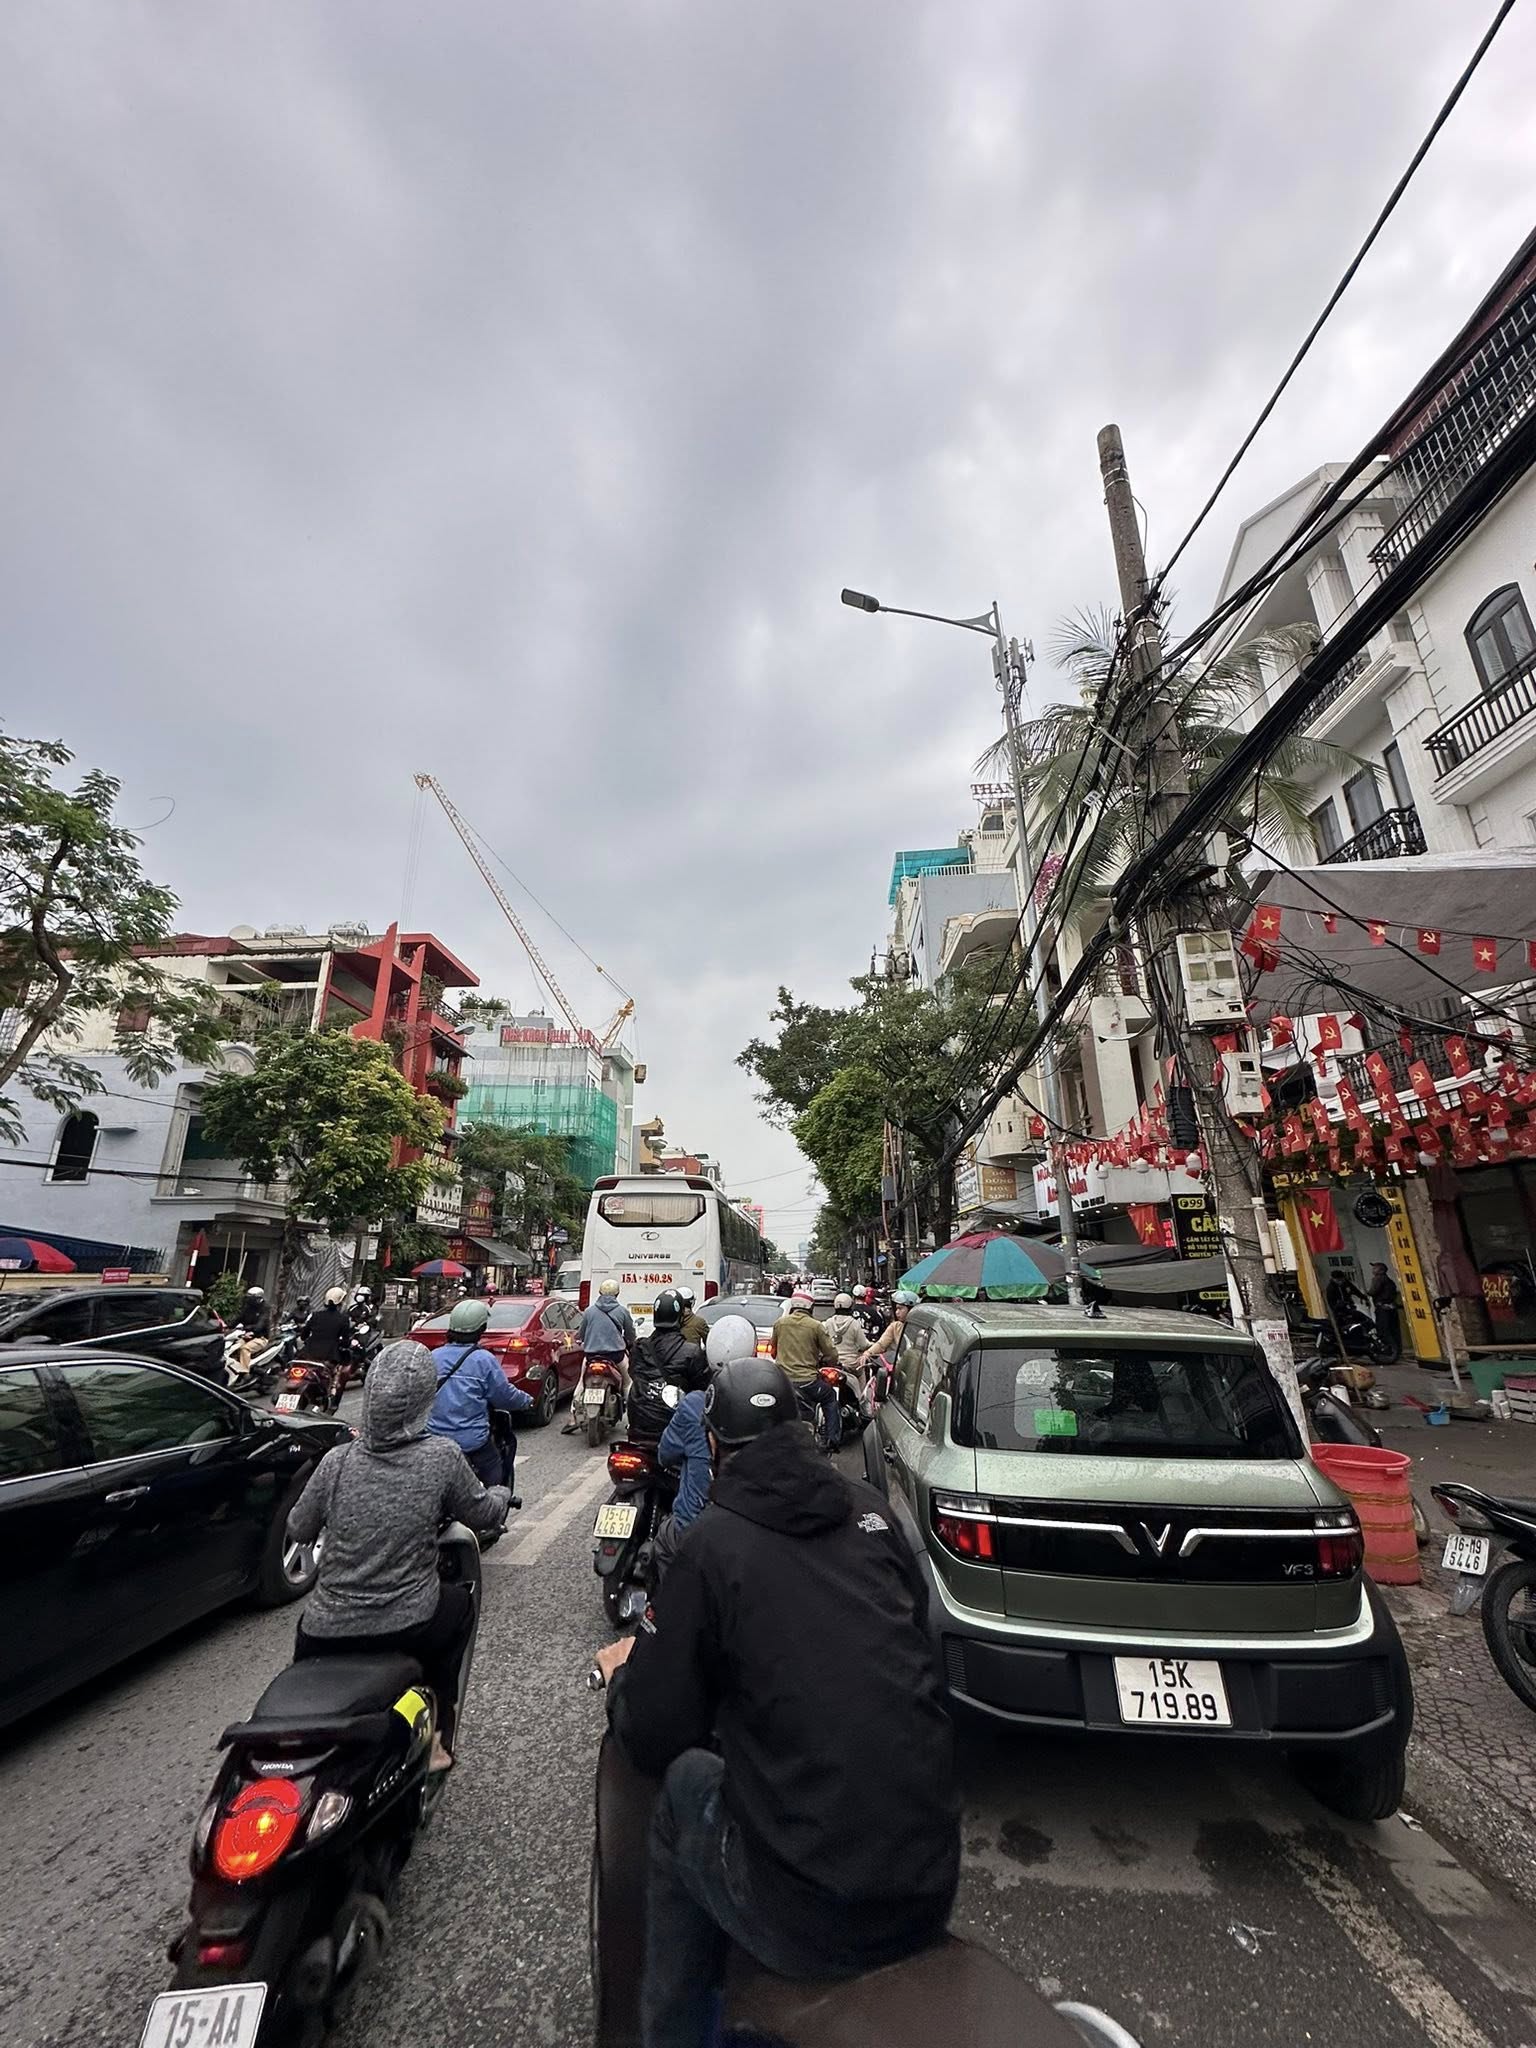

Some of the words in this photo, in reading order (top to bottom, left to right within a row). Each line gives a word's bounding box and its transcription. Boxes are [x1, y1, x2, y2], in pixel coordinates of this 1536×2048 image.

[1449, 1551, 1480, 1570] 5446
[1148, 1660, 1193, 1688] 15K
[1130, 1691, 1218, 1721] 719.89
[164, 1995, 245, 2048] 15-AA
